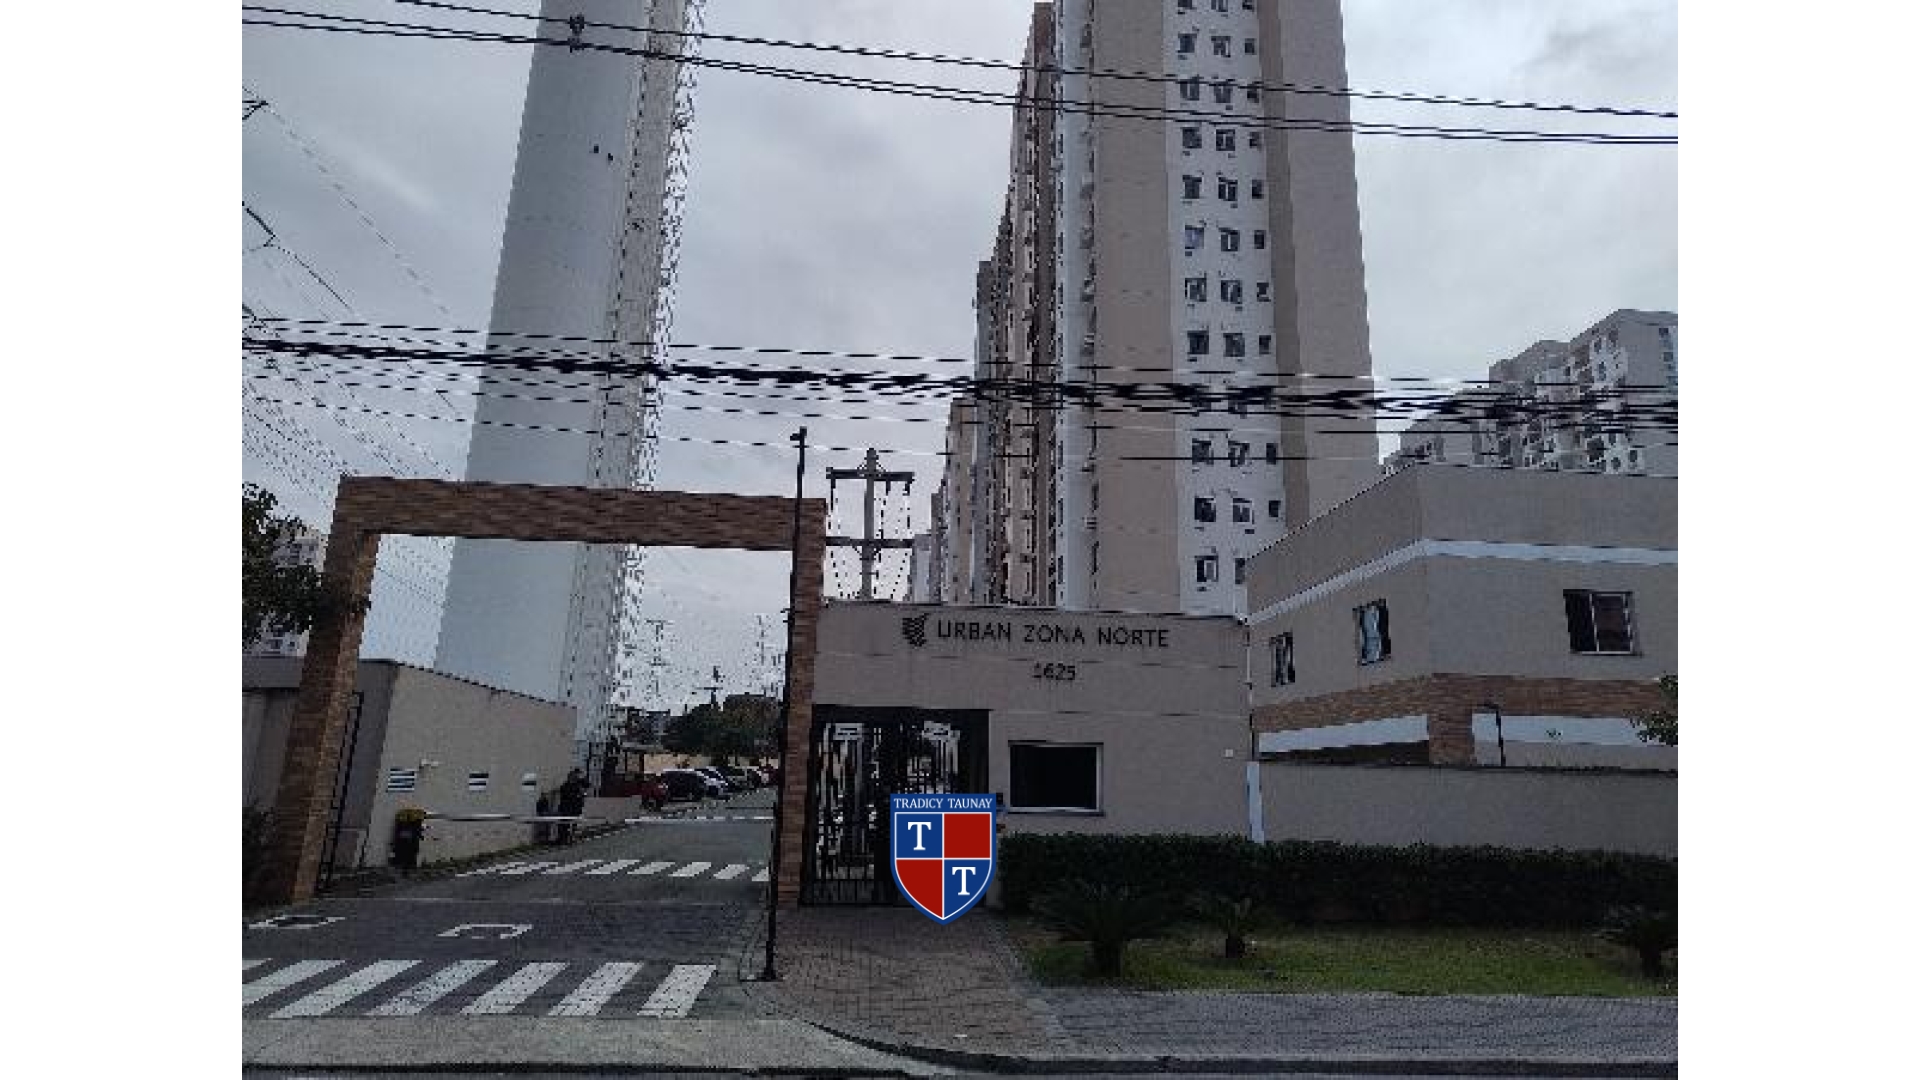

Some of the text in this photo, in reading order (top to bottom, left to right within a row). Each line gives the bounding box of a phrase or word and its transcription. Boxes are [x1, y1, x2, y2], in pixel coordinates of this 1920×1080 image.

[938, 619, 1170, 648] URBAN ZONA NORTE
[1033, 662, 1076, 681] 1625
